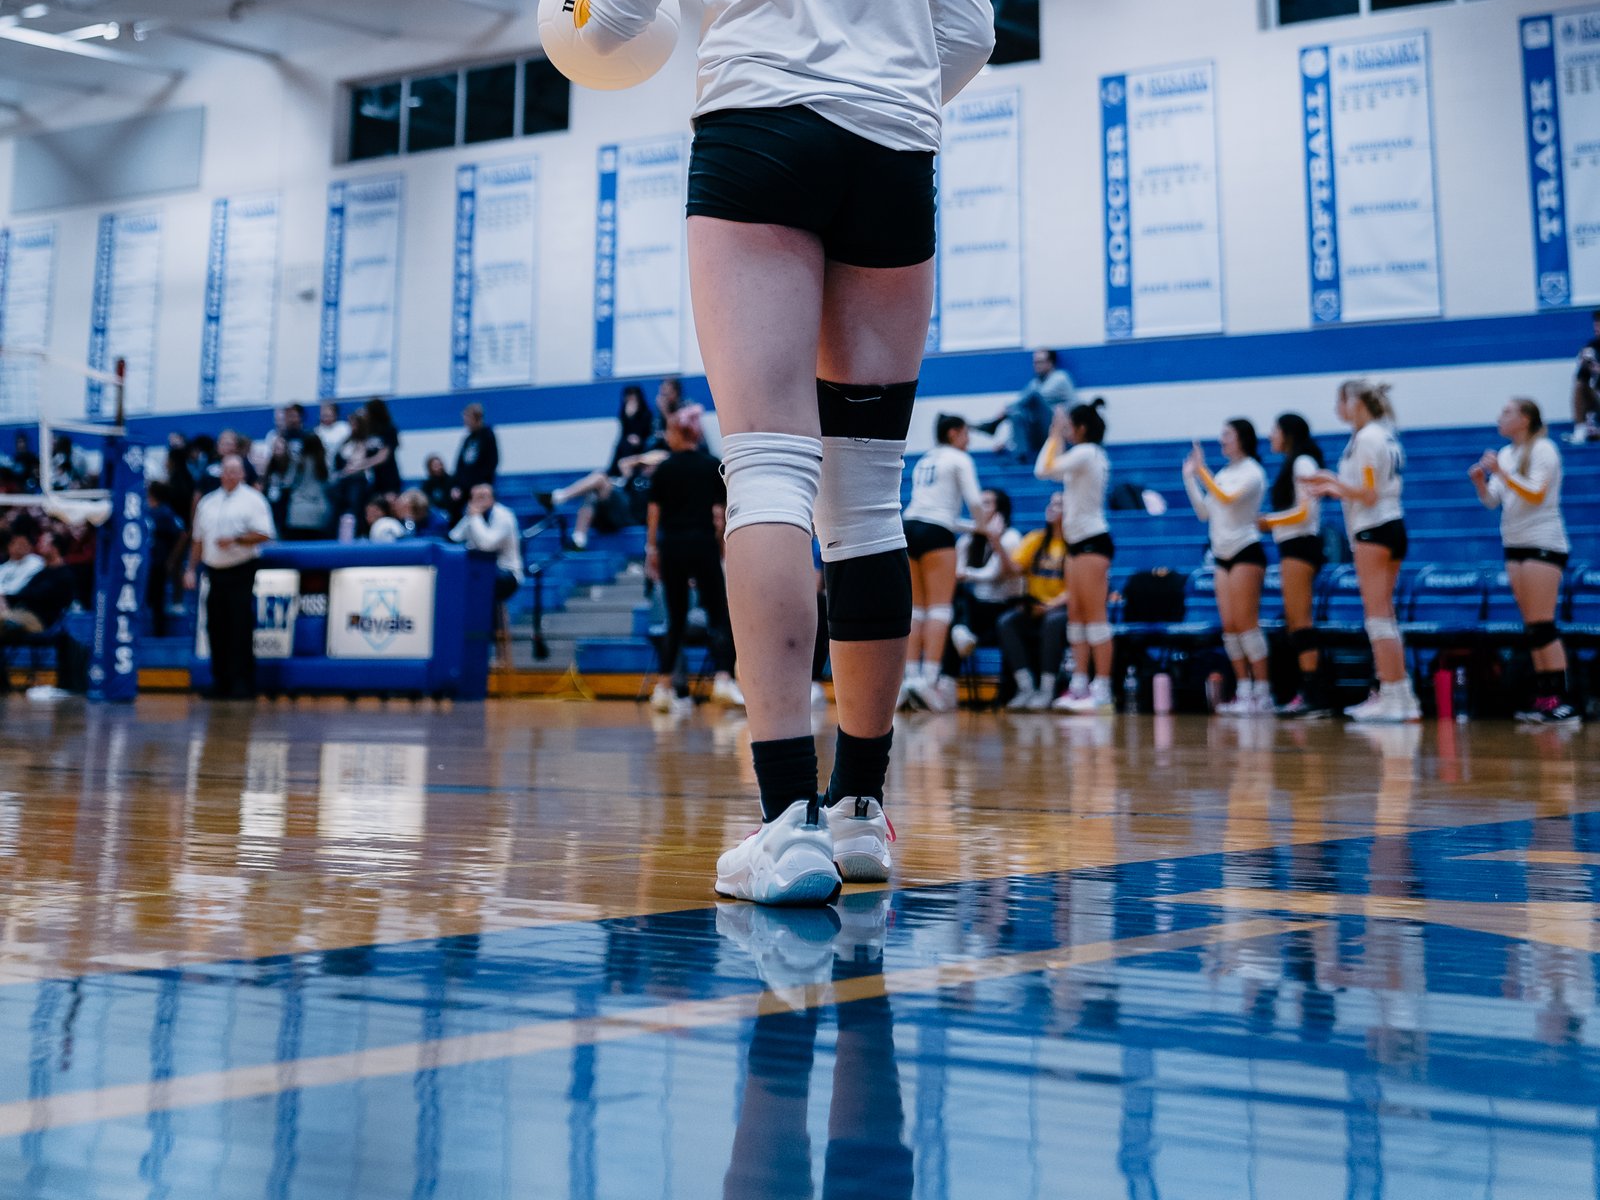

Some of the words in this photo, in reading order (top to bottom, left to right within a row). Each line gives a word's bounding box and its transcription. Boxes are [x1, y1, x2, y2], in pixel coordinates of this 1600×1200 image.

[1106, 125, 1129, 288] SOCCER
[1306, 81, 1335, 281] SOFTBALL
[1529, 79, 1562, 243] TRACK
[114, 491, 143, 675] ROYALS
[346, 612, 415, 636] Royals
